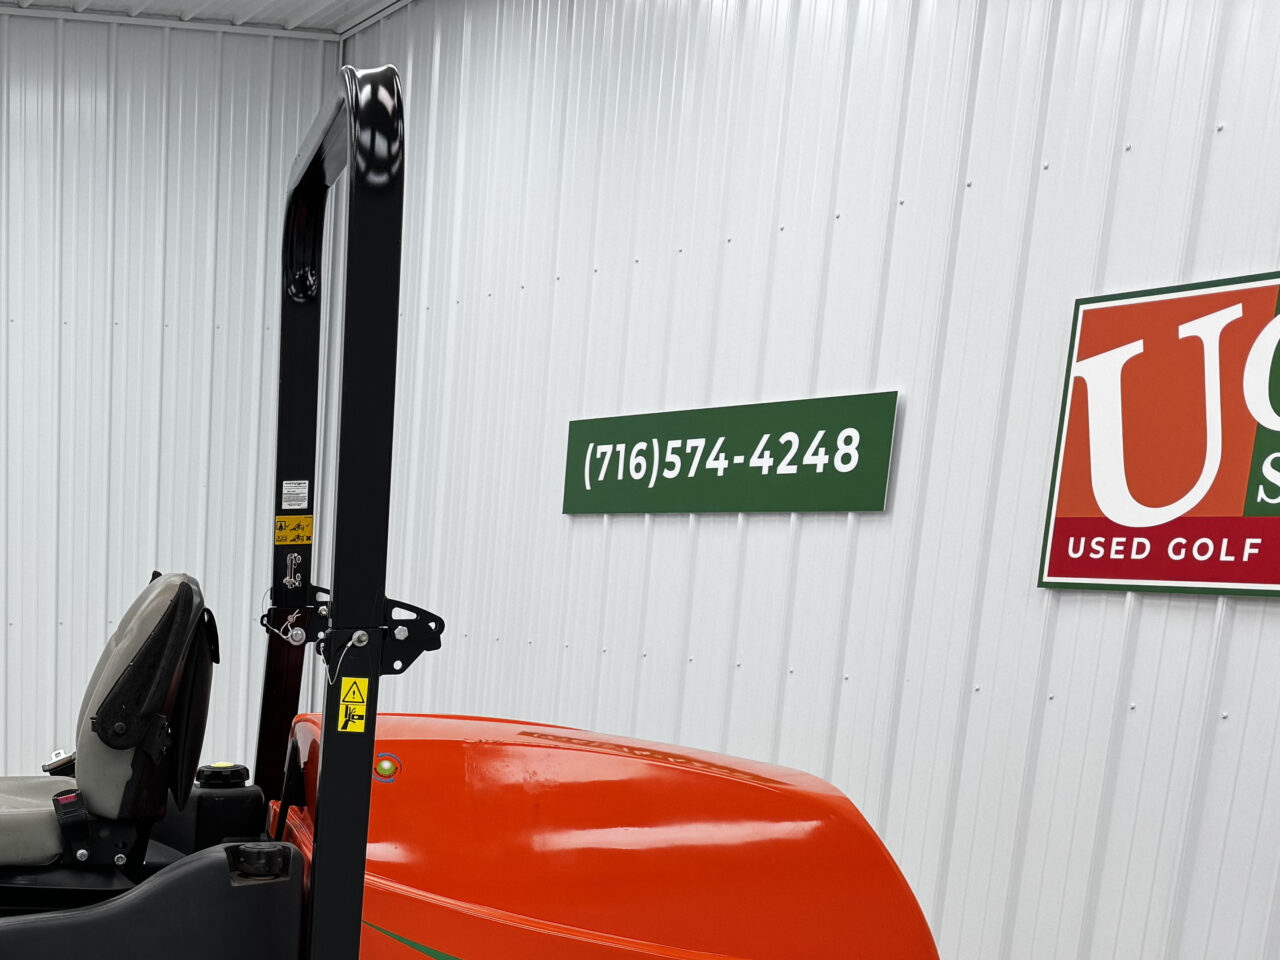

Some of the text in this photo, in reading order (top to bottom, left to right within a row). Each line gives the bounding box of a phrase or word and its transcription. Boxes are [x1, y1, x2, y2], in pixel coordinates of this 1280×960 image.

[583, 428, 861, 489] (716)574-4248
[1067, 536, 1262, 562] USED GOLF
